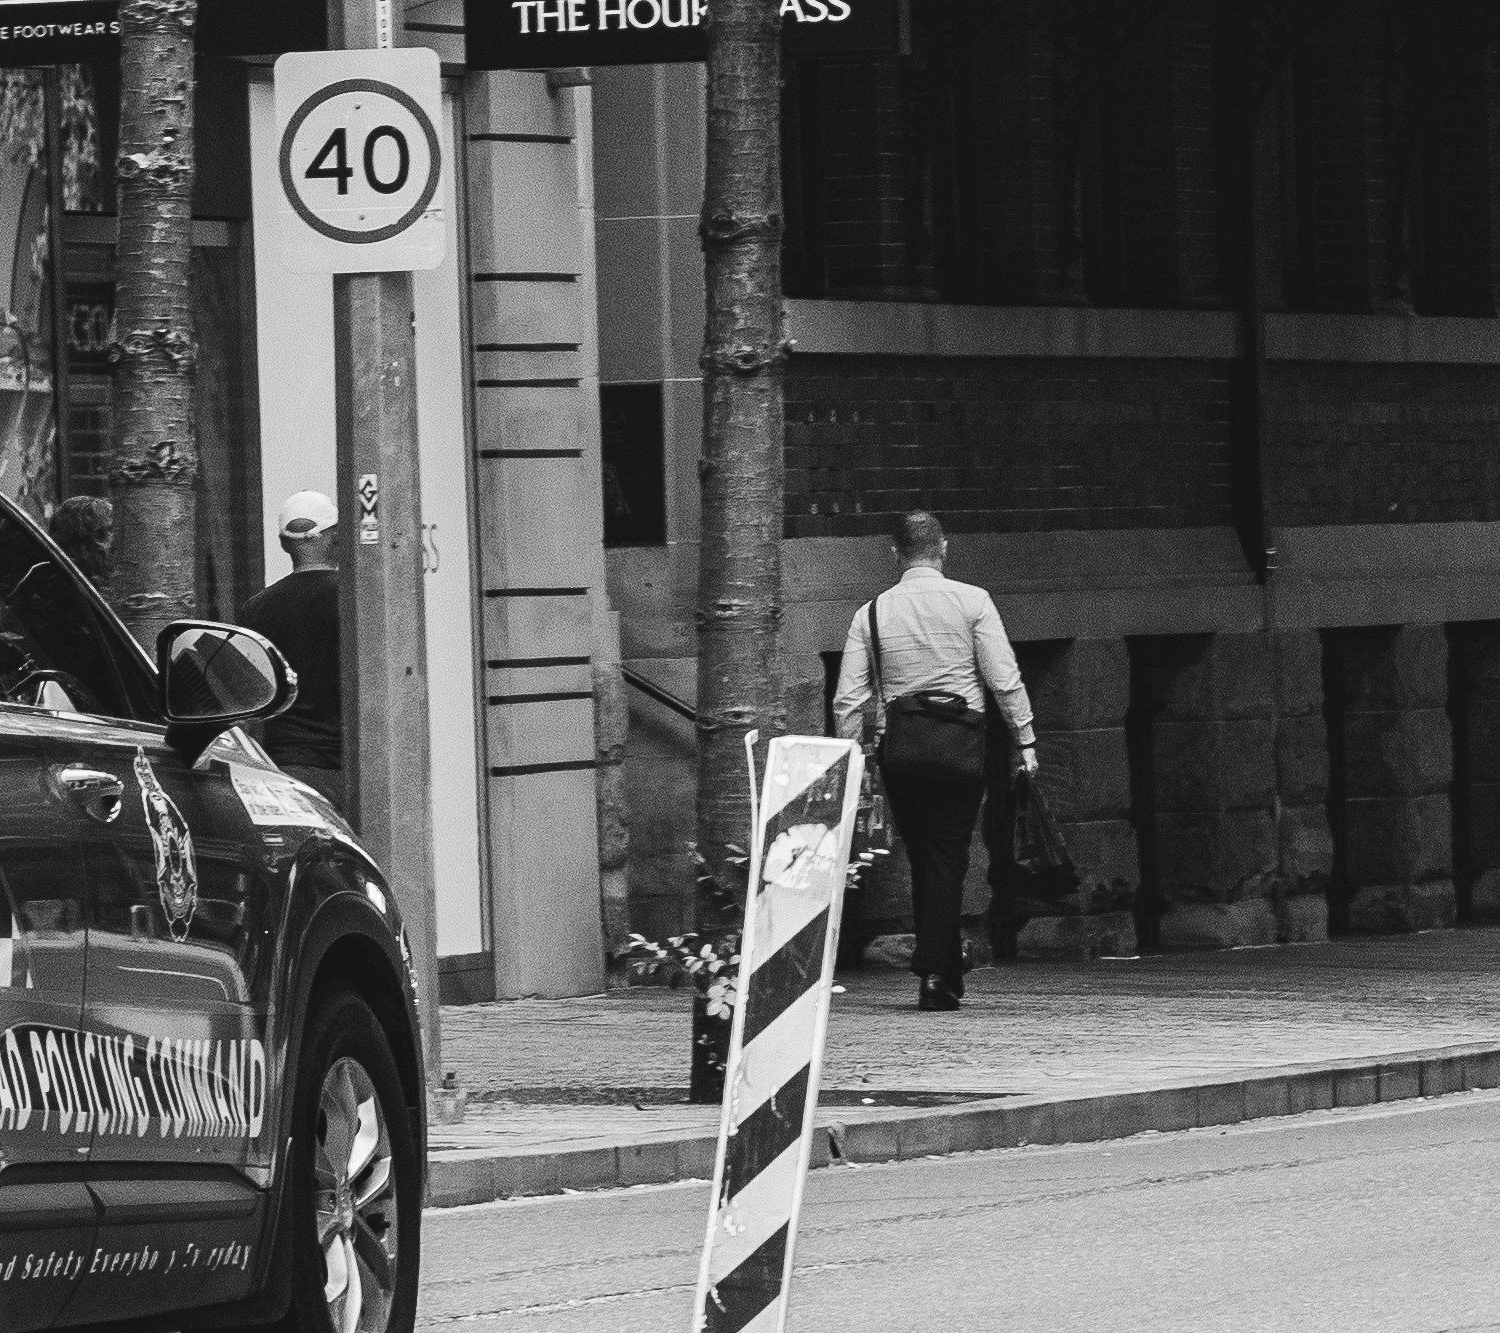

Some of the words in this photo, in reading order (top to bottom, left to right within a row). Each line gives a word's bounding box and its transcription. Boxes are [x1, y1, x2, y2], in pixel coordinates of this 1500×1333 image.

[13, 22, 106, 39] FOOTWEAR
[512, 1, 590, 33] THE
[305, 125, 410, 195] 40
[29, 1031, 150, 1137] POLICING
[146, 1036, 266, 1138] COMMAND
[21, 1250, 85, 1281] Safety
[89, 1245, 176, 1277] Everyboy
[182, 1240, 253, 1271] vryday
